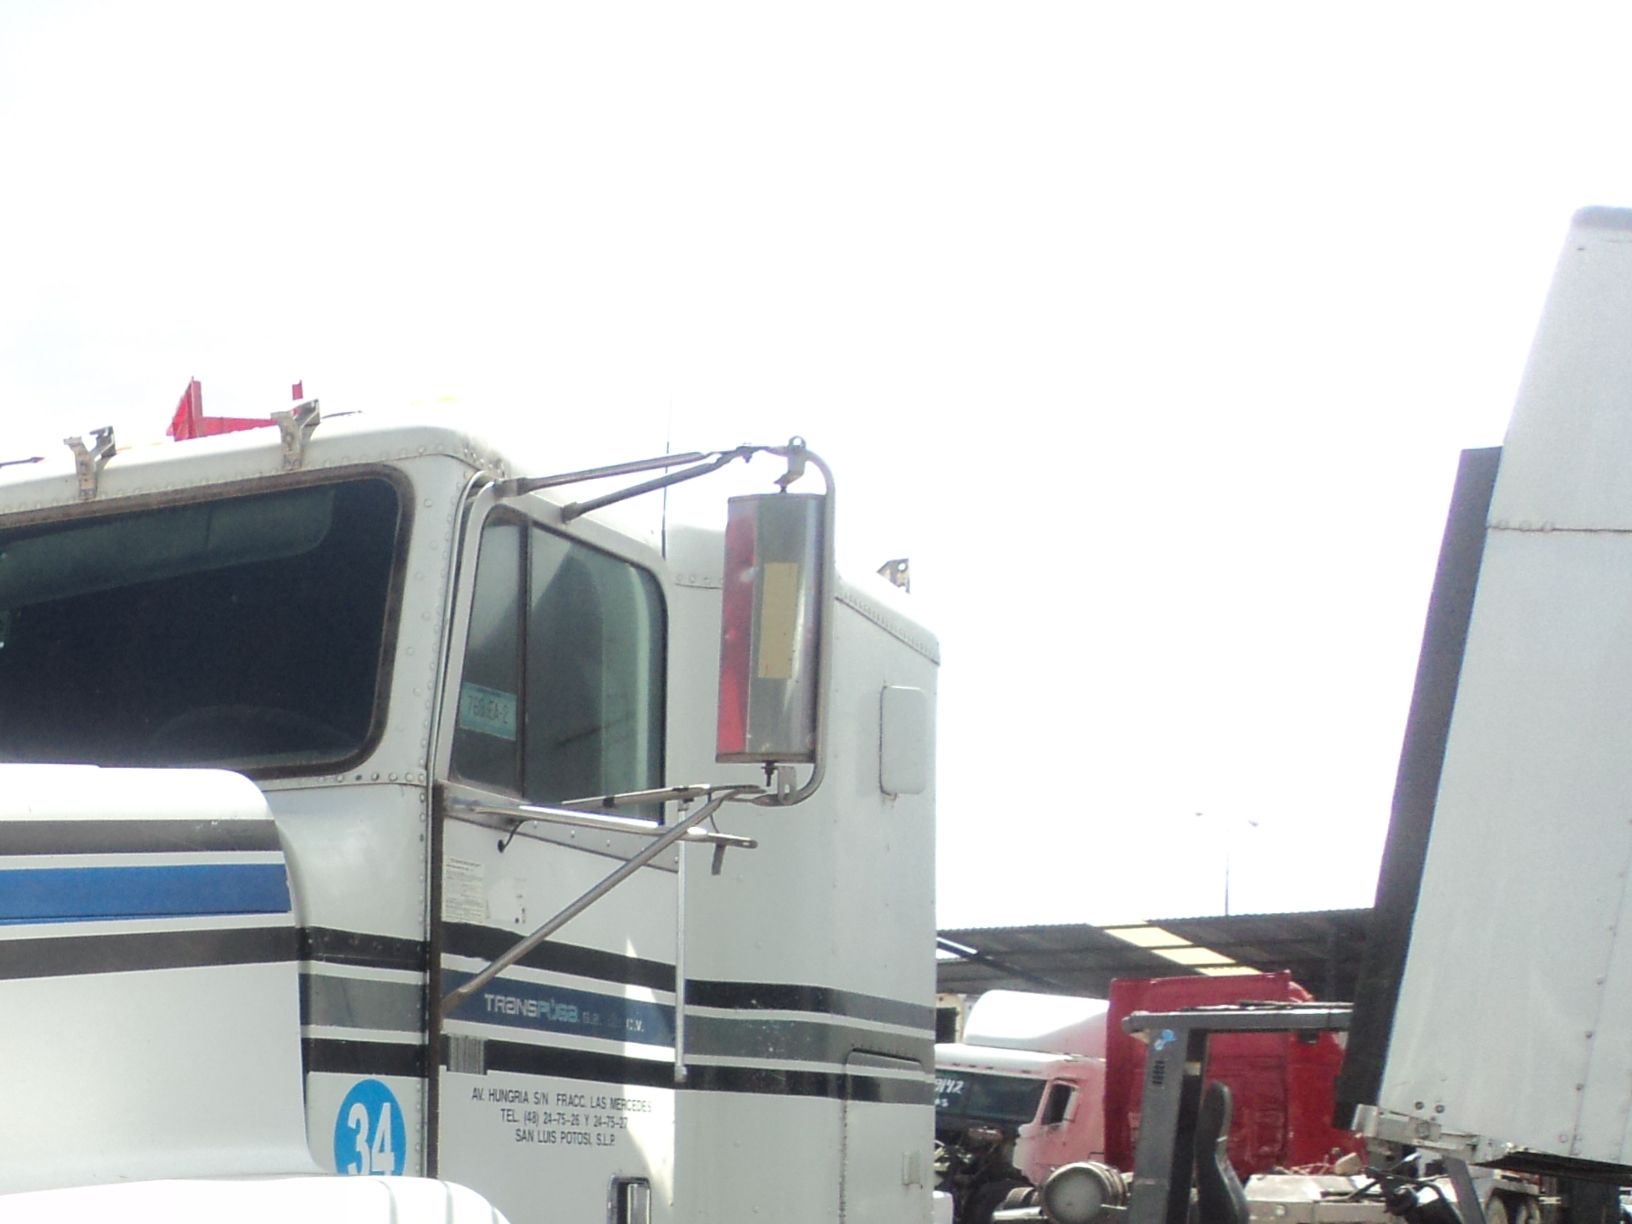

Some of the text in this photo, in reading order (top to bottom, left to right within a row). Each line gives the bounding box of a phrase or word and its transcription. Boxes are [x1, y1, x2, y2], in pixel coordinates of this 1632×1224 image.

[488, 1088, 529, 1104] HUNGRIA
[590, 1095, 607, 1110] LAS
[584, 1113, 591, 1126] Y
[348, 1102, 395, 1176] 34
[515, 1128, 535, 1144] SAN
[537, 1130, 558, 1145] LUIS
